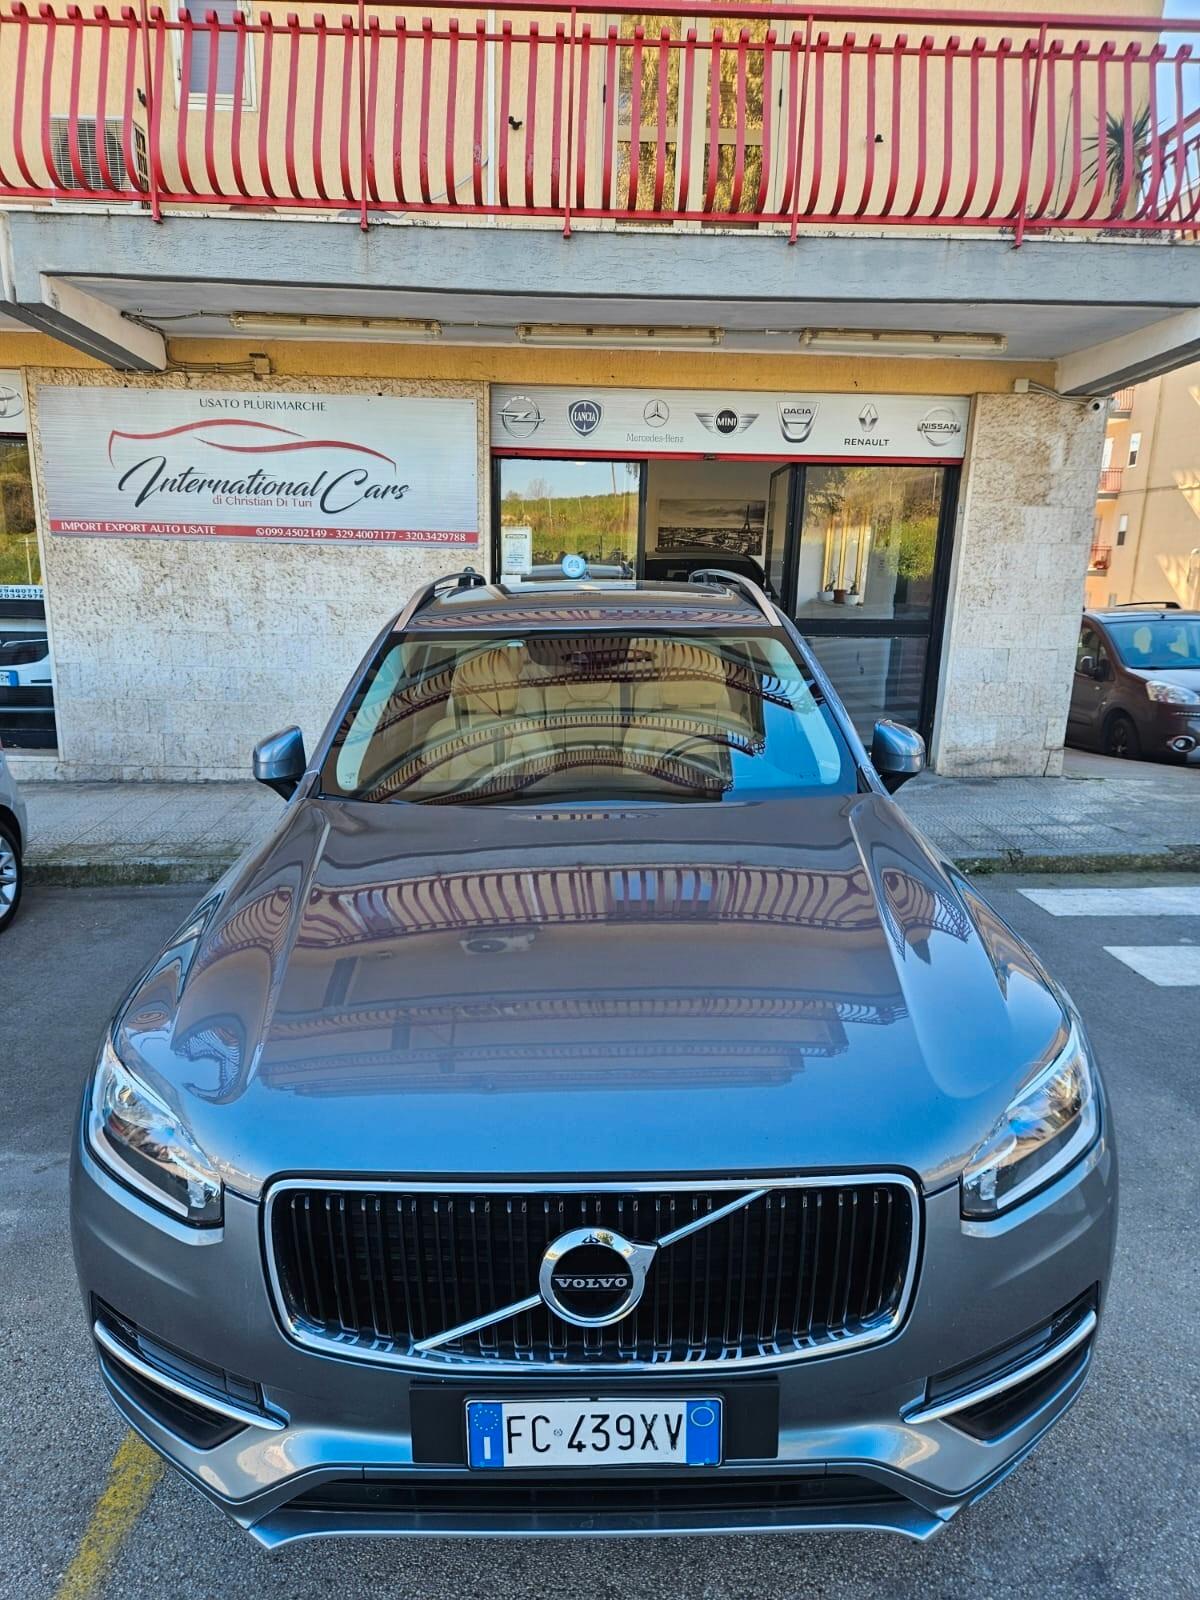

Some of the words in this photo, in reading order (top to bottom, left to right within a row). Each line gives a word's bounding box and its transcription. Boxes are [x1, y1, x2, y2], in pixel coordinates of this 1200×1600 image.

[199, 398, 240, 409] USATO
[243, 399, 327, 412] PLURIMARCHE
[783, 407, 812, 415] DACIA
[573, 411, 597, 422] LANCIA
[716, 417, 737, 426] MINI
[921, 422, 958, 431] NISSAN
[626, 432, 684, 443] Mercedes-Benz
[844, 438, 890, 447] RENAULT
[118, 456, 330, 508] International
[319, 468, 412, 514] Cars
[212, 496, 222, 505] di
[225, 495, 273, 506] Christian
[276, 497, 288, 507] Di
[292, 497, 312, 508] Turi
[61, 521, 102, 531] IMPORT
[105, 523, 147, 533] EXPORT
[150, 524, 180, 534] AUTO
[183, 525, 217, 535] USATE
[265, 527, 327, 538] 099.4502149
[335, 529, 397, 540] 329.4007177
[405, 530, 466, 542] 320.3429788
[555, 1277, 628, 1289] VOLVO
[506, 1415, 551, 1454] FC
[567, 1413, 684, 1453] 439XV
